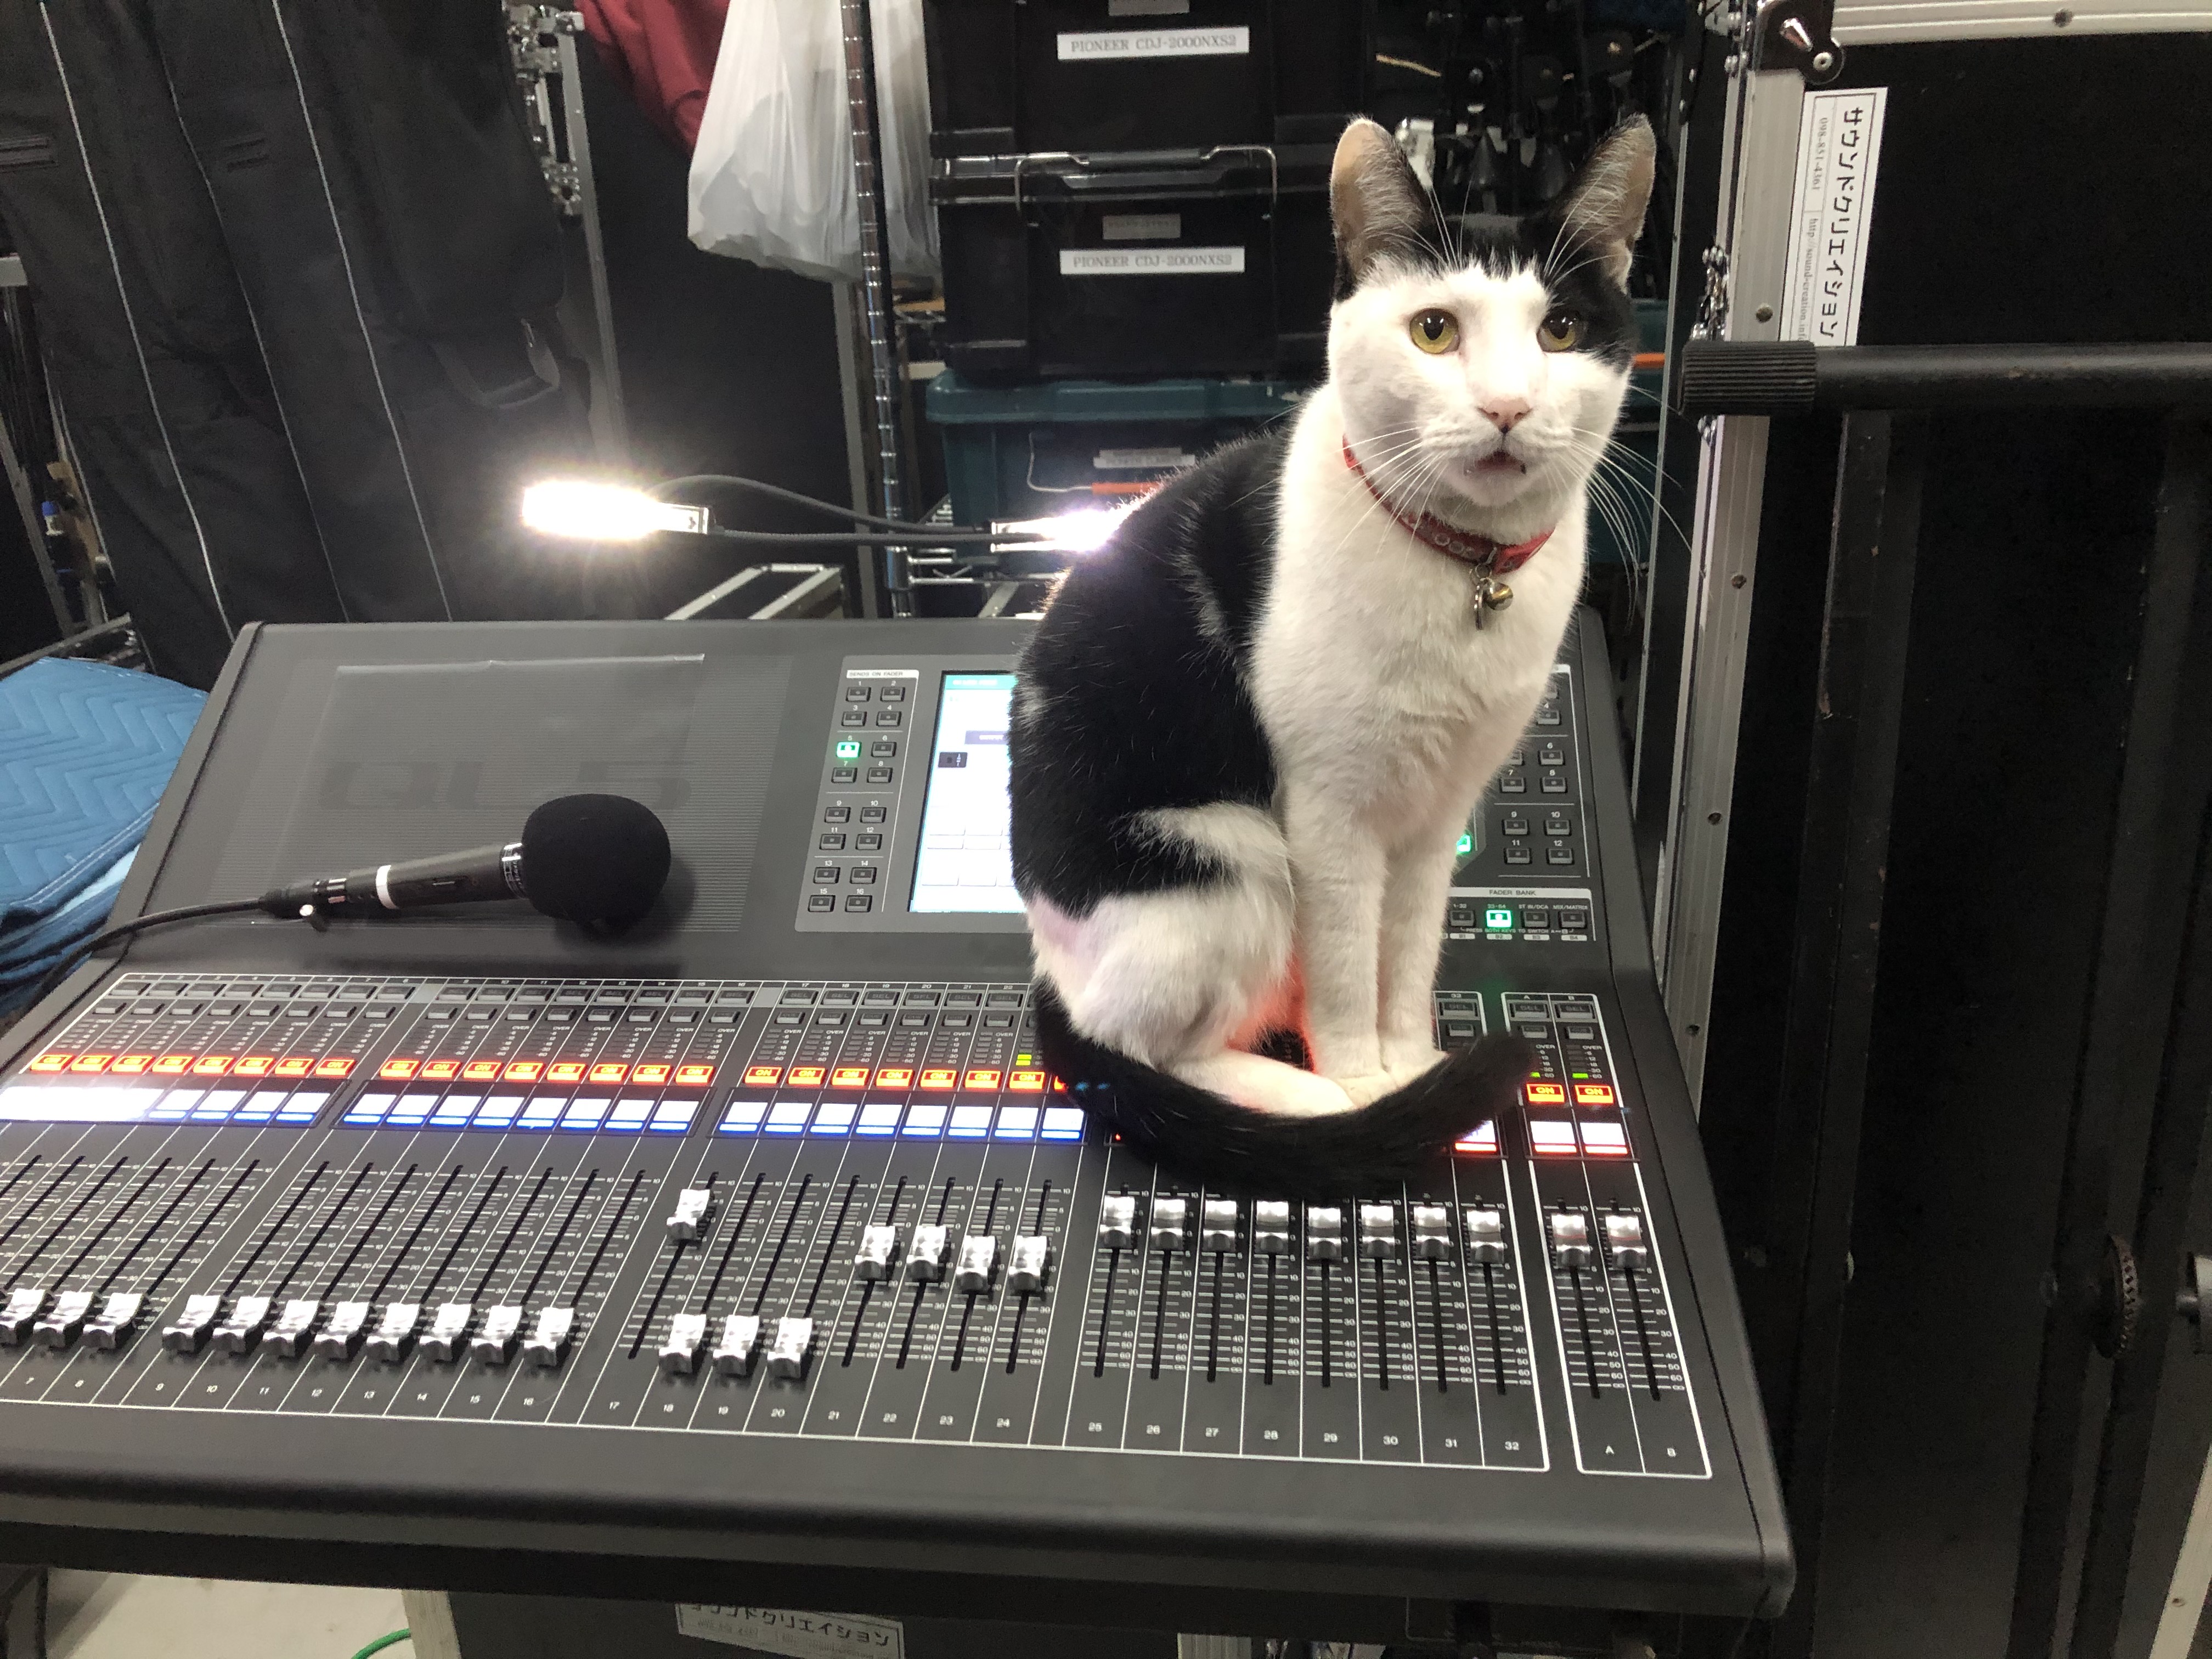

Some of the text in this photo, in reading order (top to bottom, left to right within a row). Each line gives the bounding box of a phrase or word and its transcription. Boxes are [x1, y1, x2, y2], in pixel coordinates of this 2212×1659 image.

[1071, 35, 1237, 53] PIONEER CDJ-2000NXS2
[1820, 107, 1864, 338] サウンドクリエイション
[1074, 255, 1232, 268] PIONEER CDJ-2000NXS2
[719, 1407, 728, 1415] 19
[771, 1409, 785, 1417] 20
[828, 1411, 839, 1419] 21
[883, 1413, 896, 1422] 22
[940, 1416, 953, 1425] 23
[997, 1418, 1009, 1427] 24
[1088, 1423, 1102, 1431] 25
[1147, 1425, 1160, 1434] 26
[1206, 1427, 1218, 1436] 27
[1264, 1431, 1278, 1440] 28
[1324, 1433, 1338, 1442] 29
[1383, 1436, 1398, 1445] 30
[1446, 1439, 1457, 1447] 31
[1505, 1442, 1519, 1450] 32
[1606, 1446, 1614, 1454] A
[1667, 1448, 1676, 1457] B
